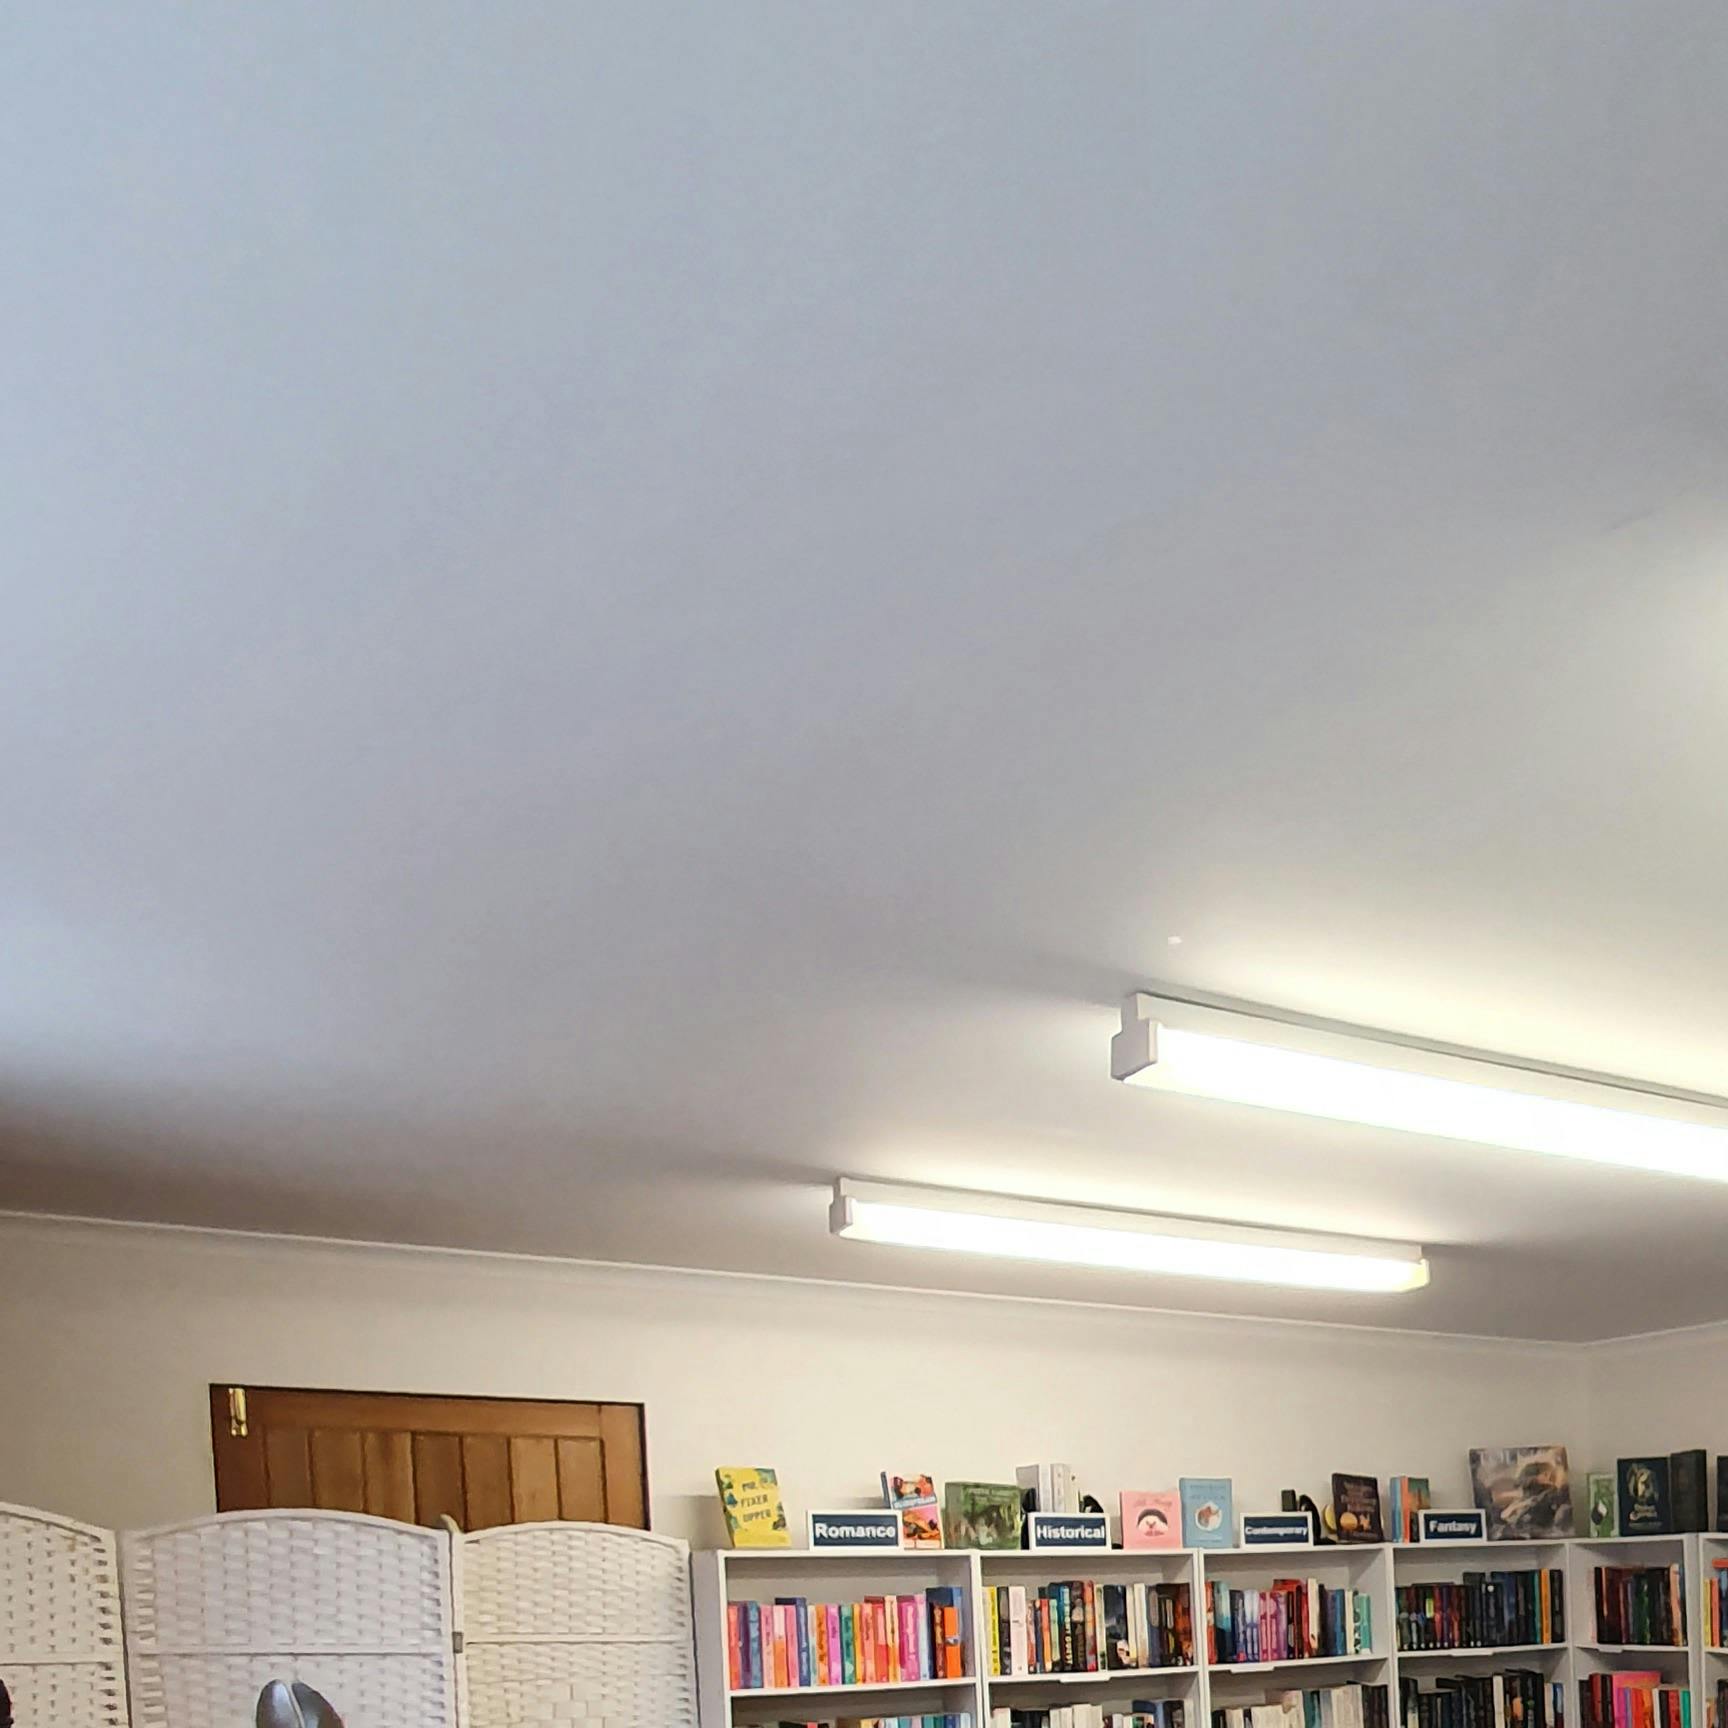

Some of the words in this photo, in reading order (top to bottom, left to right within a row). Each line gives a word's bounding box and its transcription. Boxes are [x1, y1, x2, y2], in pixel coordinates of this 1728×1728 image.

[743, 1509, 771, 1522] UPPER
[815, 1522, 896, 1539] Romance
[1036, 1524, 1105, 1539] Historical
[1245, 1524, 1309, 1537] Contemporary
[1429, 1520, 1478, 1534] Fantasy
